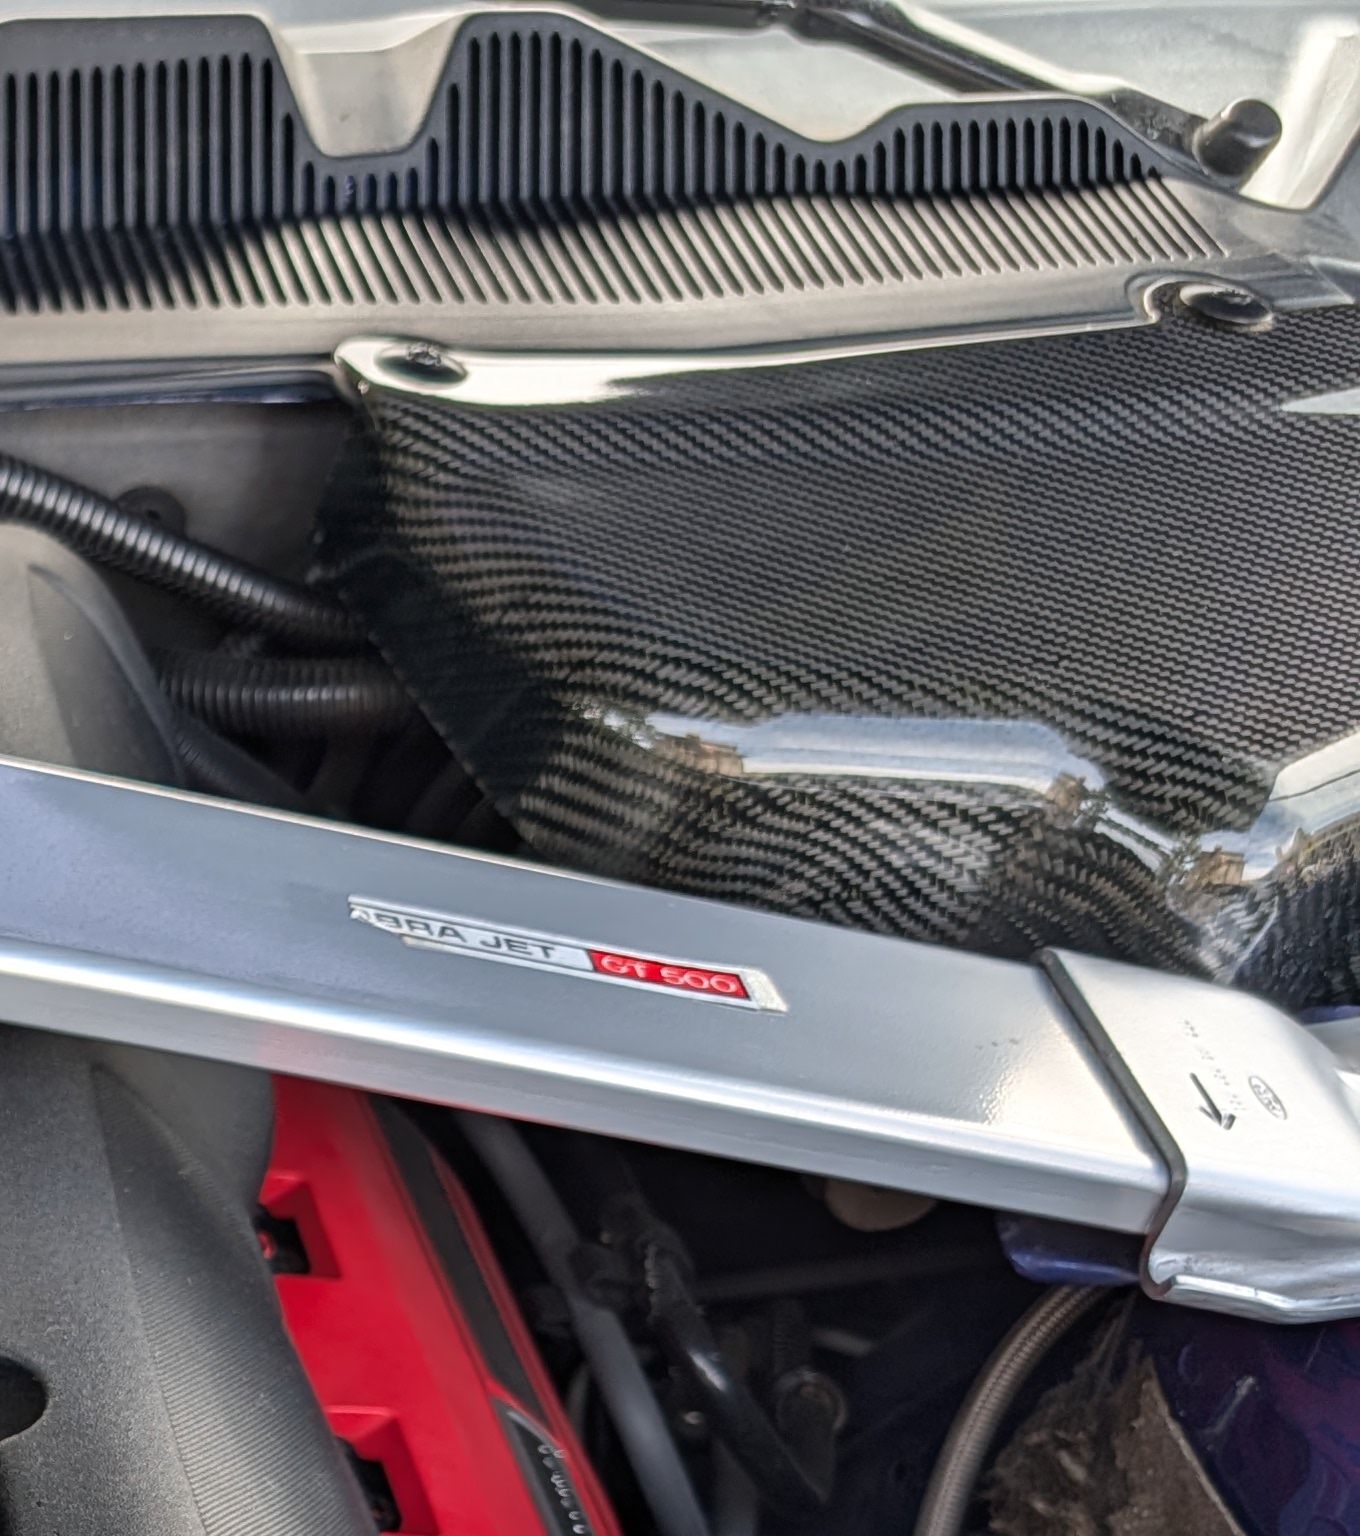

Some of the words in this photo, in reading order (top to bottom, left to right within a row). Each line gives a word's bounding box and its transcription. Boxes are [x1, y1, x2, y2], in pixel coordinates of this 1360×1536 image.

[480, 935, 556, 960] JET
[600, 955, 648, 979] GT
[659, 965, 738, 994] 500
